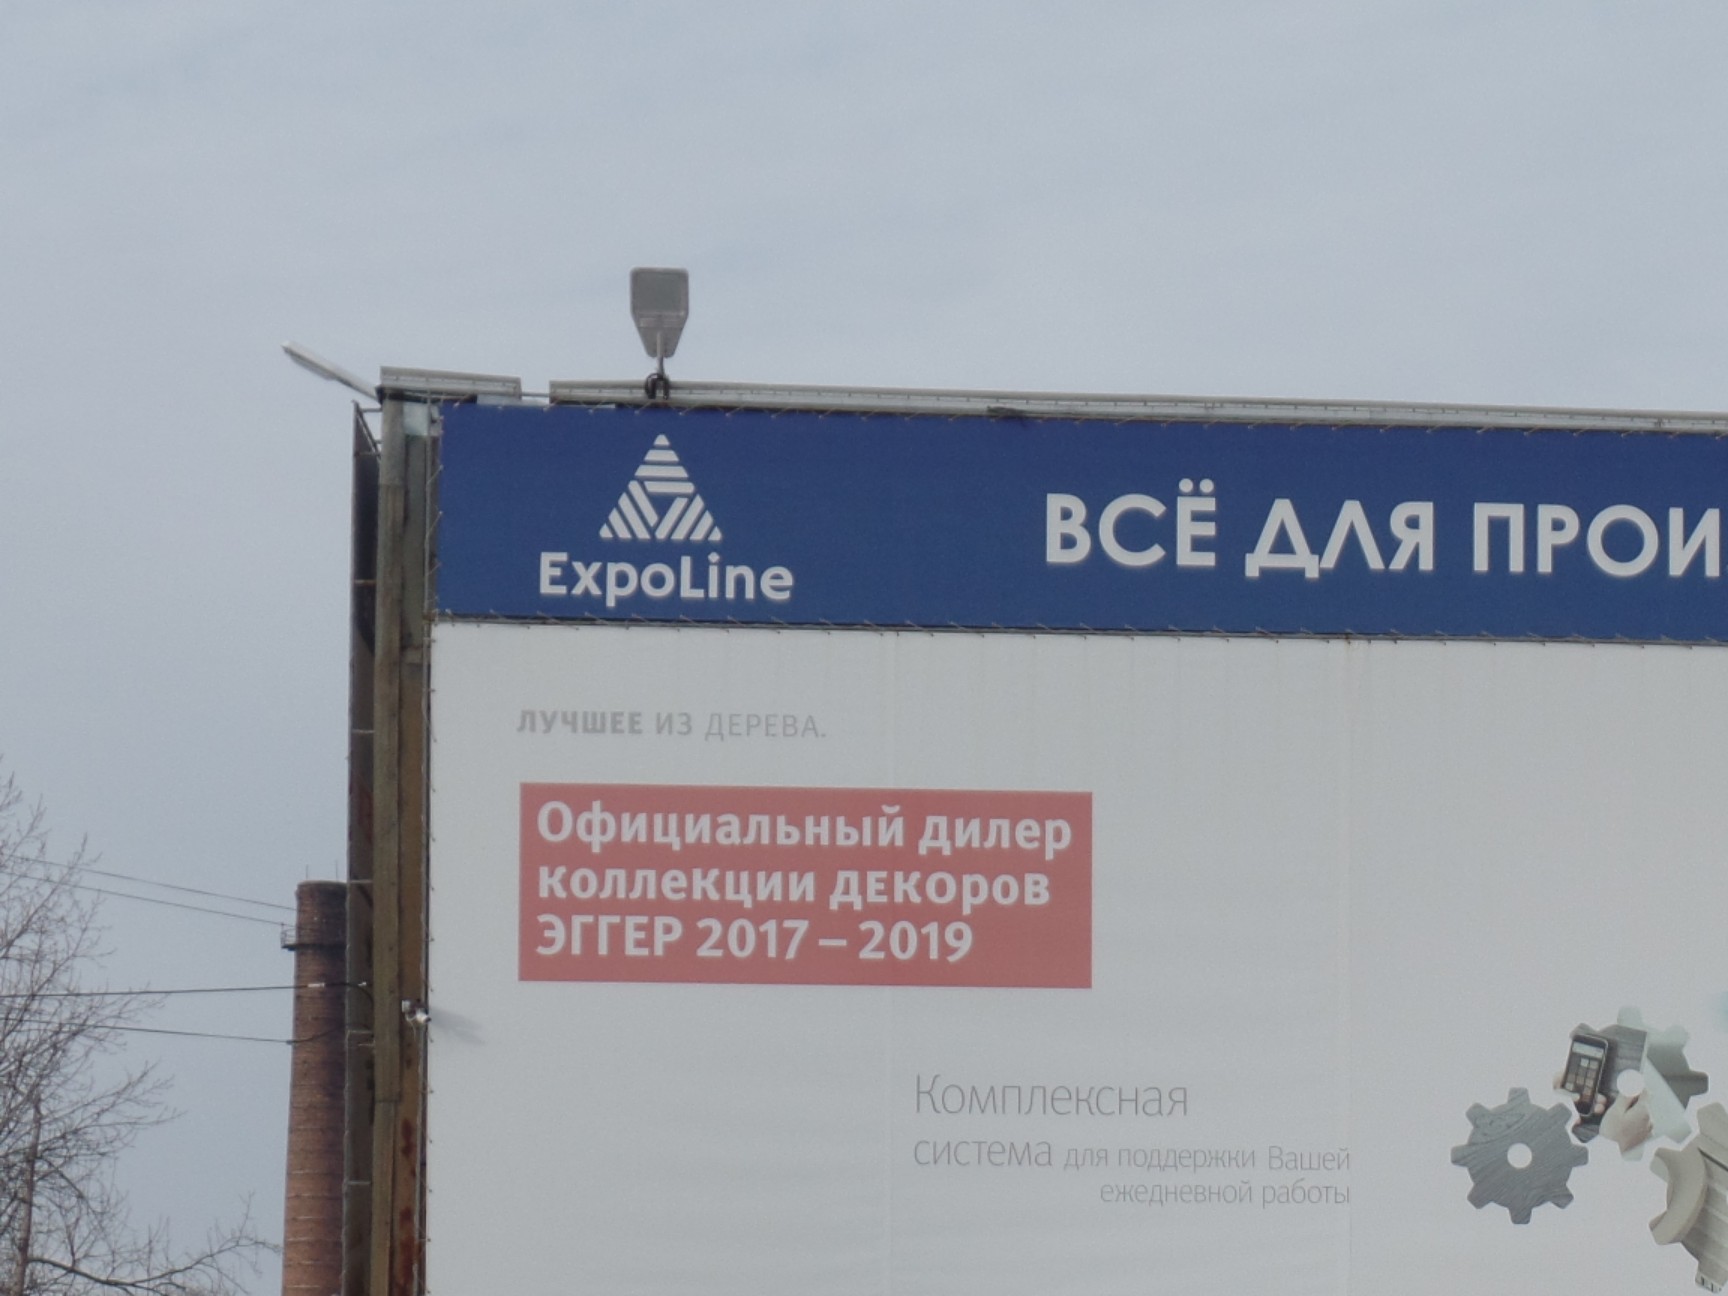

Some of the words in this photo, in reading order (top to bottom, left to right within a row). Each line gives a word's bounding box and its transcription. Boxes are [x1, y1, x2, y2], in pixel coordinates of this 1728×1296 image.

[1045, 477, 1217, 568] ВСЁ
[1244, 497, 1435, 580] ДЛЯ
[538, 551, 795, 608] ExpoLine
[517, 709, 643, 735] ЛУЧШЕЕ
[655, 712, 693, 736] ИЗ
[704, 712, 827, 742] ДЕРЕВА.
[537, 800, 904, 854] Официальный
[918, 815, 1072, 861] дилер
[538, 866, 815, 909] коллекции
[536, 913, 683, 956] ЭГГЕР
[696, 917, 810, 960] 2017
[858, 920, 974, 963] 2019
[916, 1073, 1188, 1117] Комплексная
[913, 1140, 1053, 1167] система
[1063, 1148, 1109, 1171] для
[1117, 1148, 1256, 1174] поддержки
[1268, 1145, 1351, 1171] Вашей
[1100, 1180, 1253, 1207] ежедневной
[1261, 1177, 1350, 1210] работы
